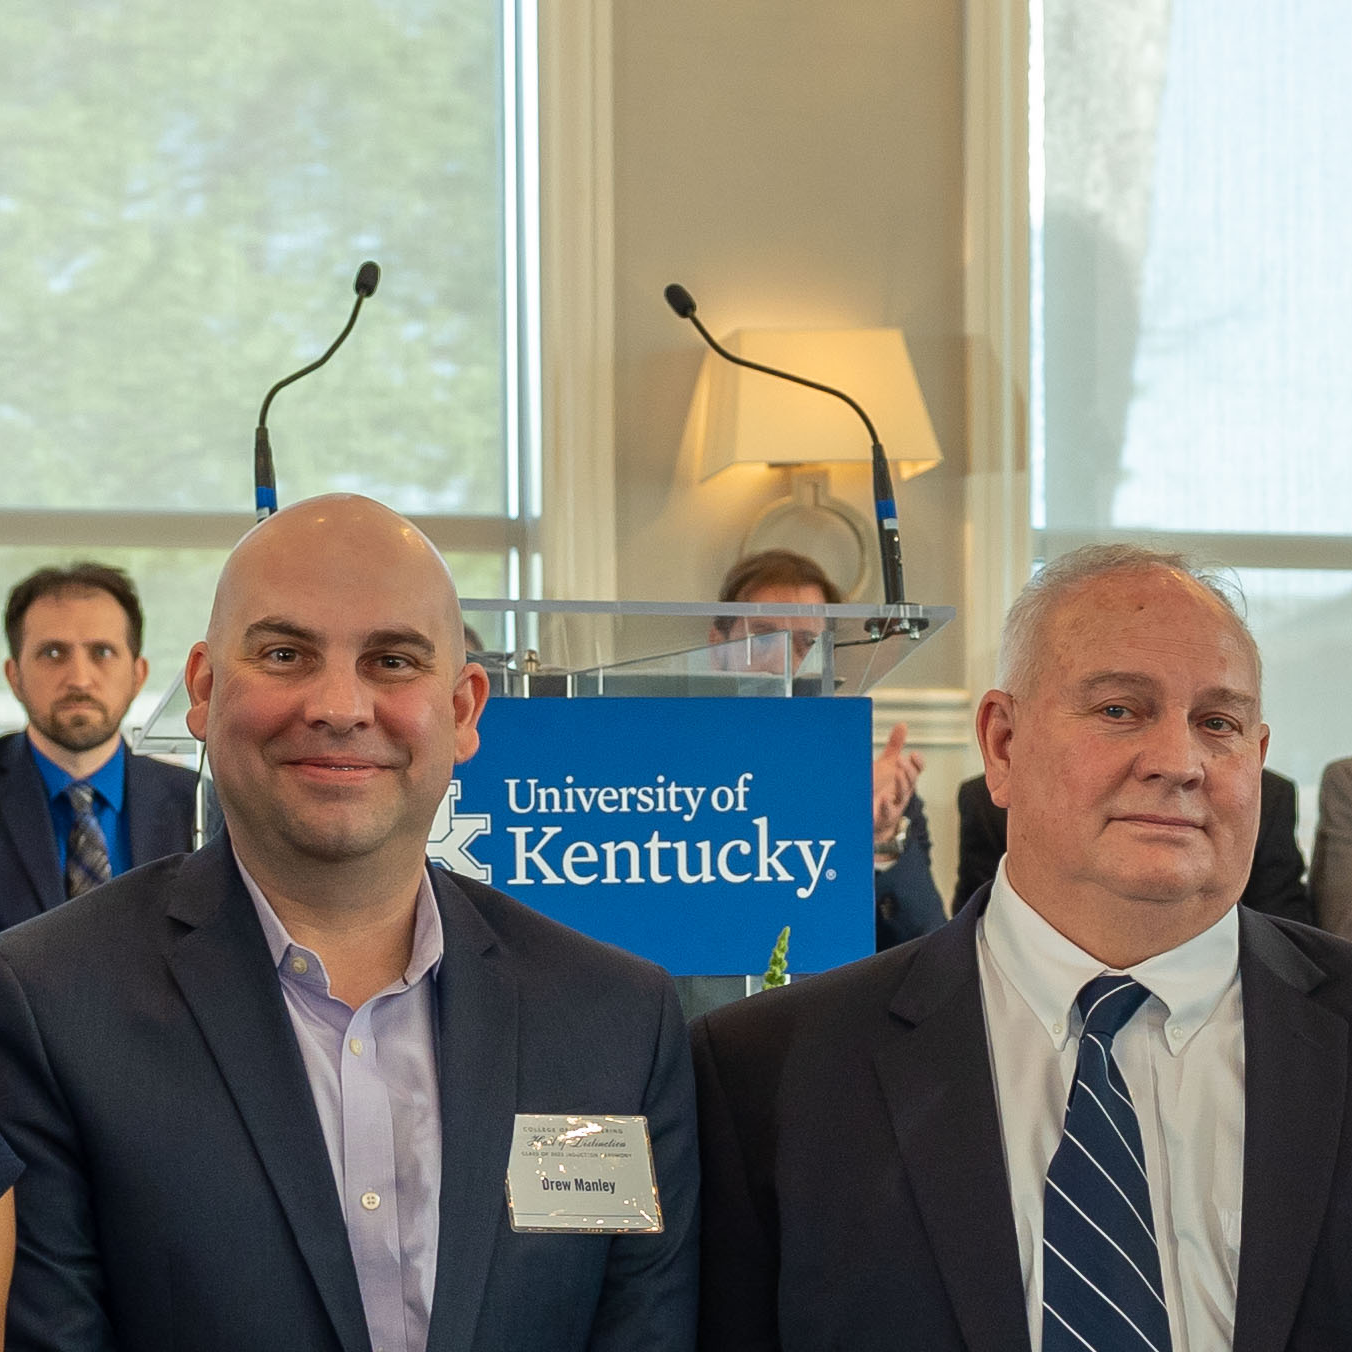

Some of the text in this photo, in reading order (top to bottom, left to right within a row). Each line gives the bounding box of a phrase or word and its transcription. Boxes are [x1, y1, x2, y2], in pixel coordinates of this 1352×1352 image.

[505, 772, 754, 822] University of
[542, 1177, 616, 1194] Drew Manley
